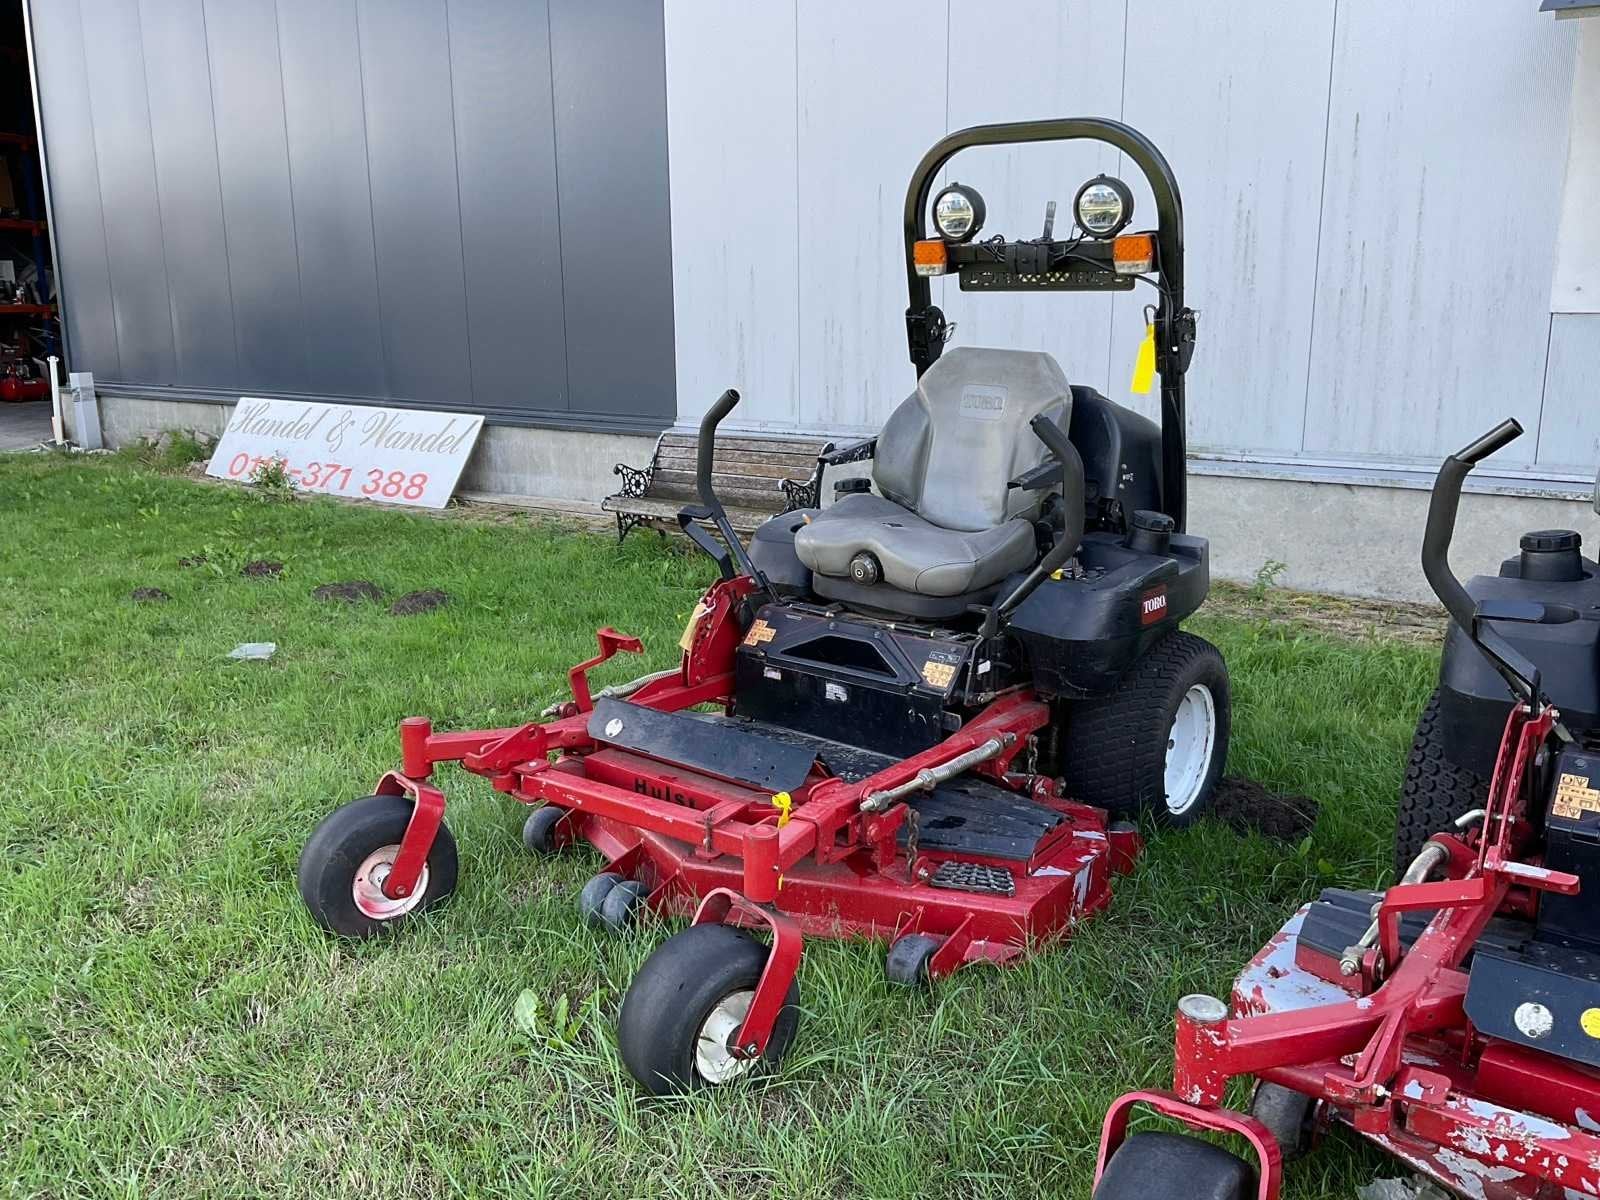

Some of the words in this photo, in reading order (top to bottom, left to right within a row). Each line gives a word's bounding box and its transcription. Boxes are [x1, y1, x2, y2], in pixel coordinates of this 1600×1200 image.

[229, 401, 332, 441] Handel
[325, 409, 356, 453] &
[359, 411, 479, 455] Wandel
[361, 468, 428, 500] 388
[1143, 594, 1167, 614] TORO
